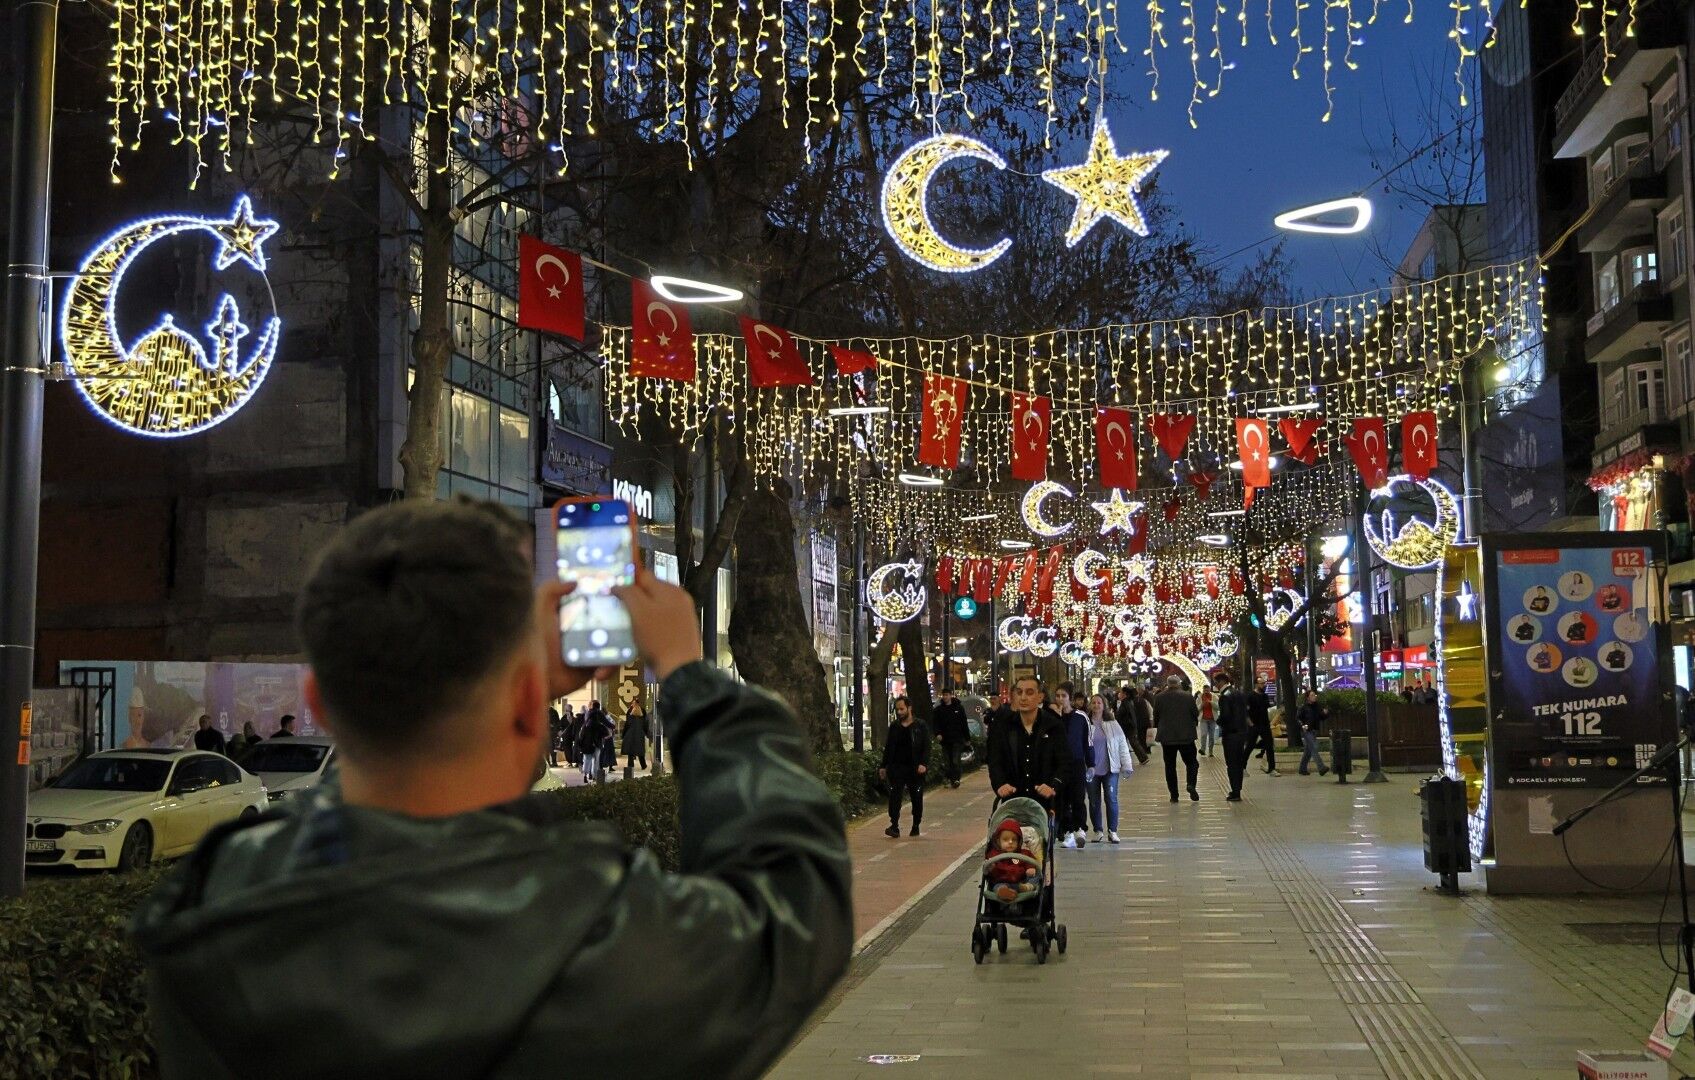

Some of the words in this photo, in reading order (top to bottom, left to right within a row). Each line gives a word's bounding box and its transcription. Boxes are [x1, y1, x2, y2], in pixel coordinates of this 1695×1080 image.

[1616, 551, 1640, 565] 112
[1532, 702, 1560, 716] TEK
[1562, 694, 1628, 712] NUMARA
[1560, 712, 1602, 735] 112
